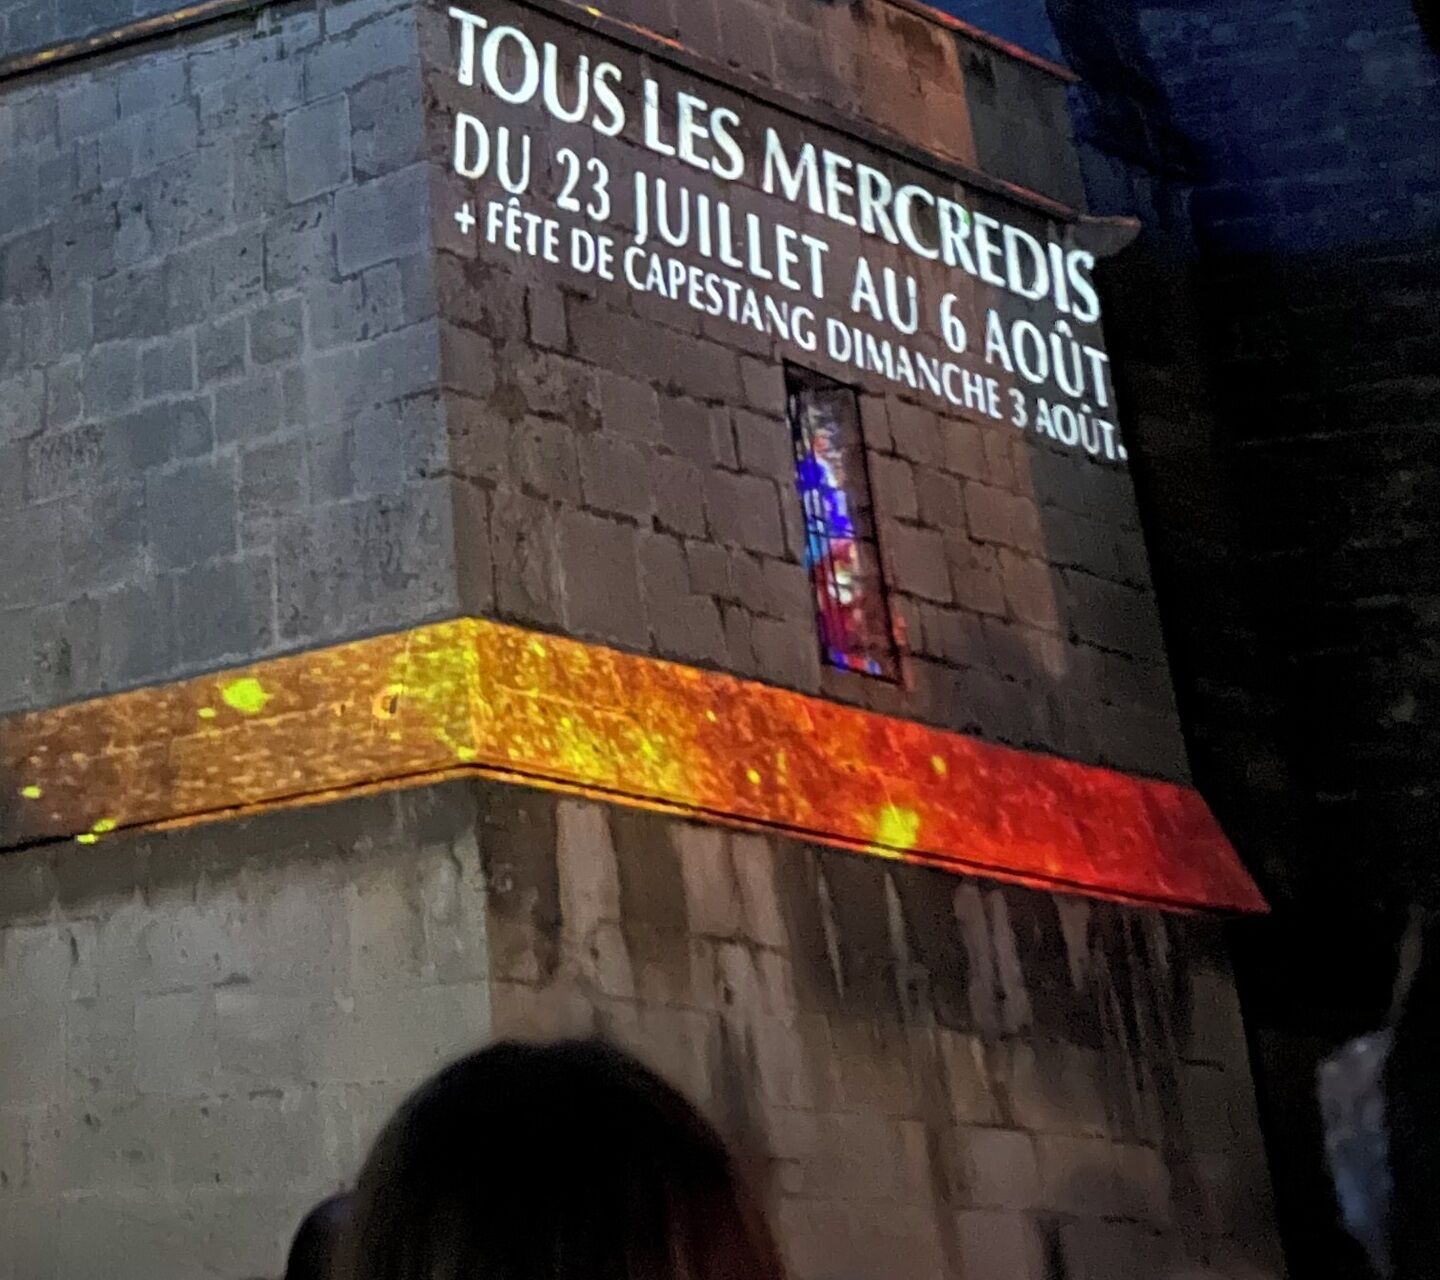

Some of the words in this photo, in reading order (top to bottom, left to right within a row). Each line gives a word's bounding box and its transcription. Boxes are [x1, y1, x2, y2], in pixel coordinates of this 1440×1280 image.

[448, 6, 626, 137] TOUS
[643, 78, 745, 181] LES
[761, 127, 1100, 323] MERCREDIS
[453, 111, 531, 195] DU
[555, 147, 611, 222] 23
[633, 170, 830, 299] JUILLET
[850, 256, 919, 335] AU
[939, 292, 968, 354] 6
[984, 308, 1109, 408] AOÛT
[486, 196, 560, 264] FÊTE
[570, 227, 615, 281] DE
[623, 245, 818, 352] CAPESTANG
[825, 317, 1004, 420] DIMANCHE
[1007, 387, 1028, 428] 3
